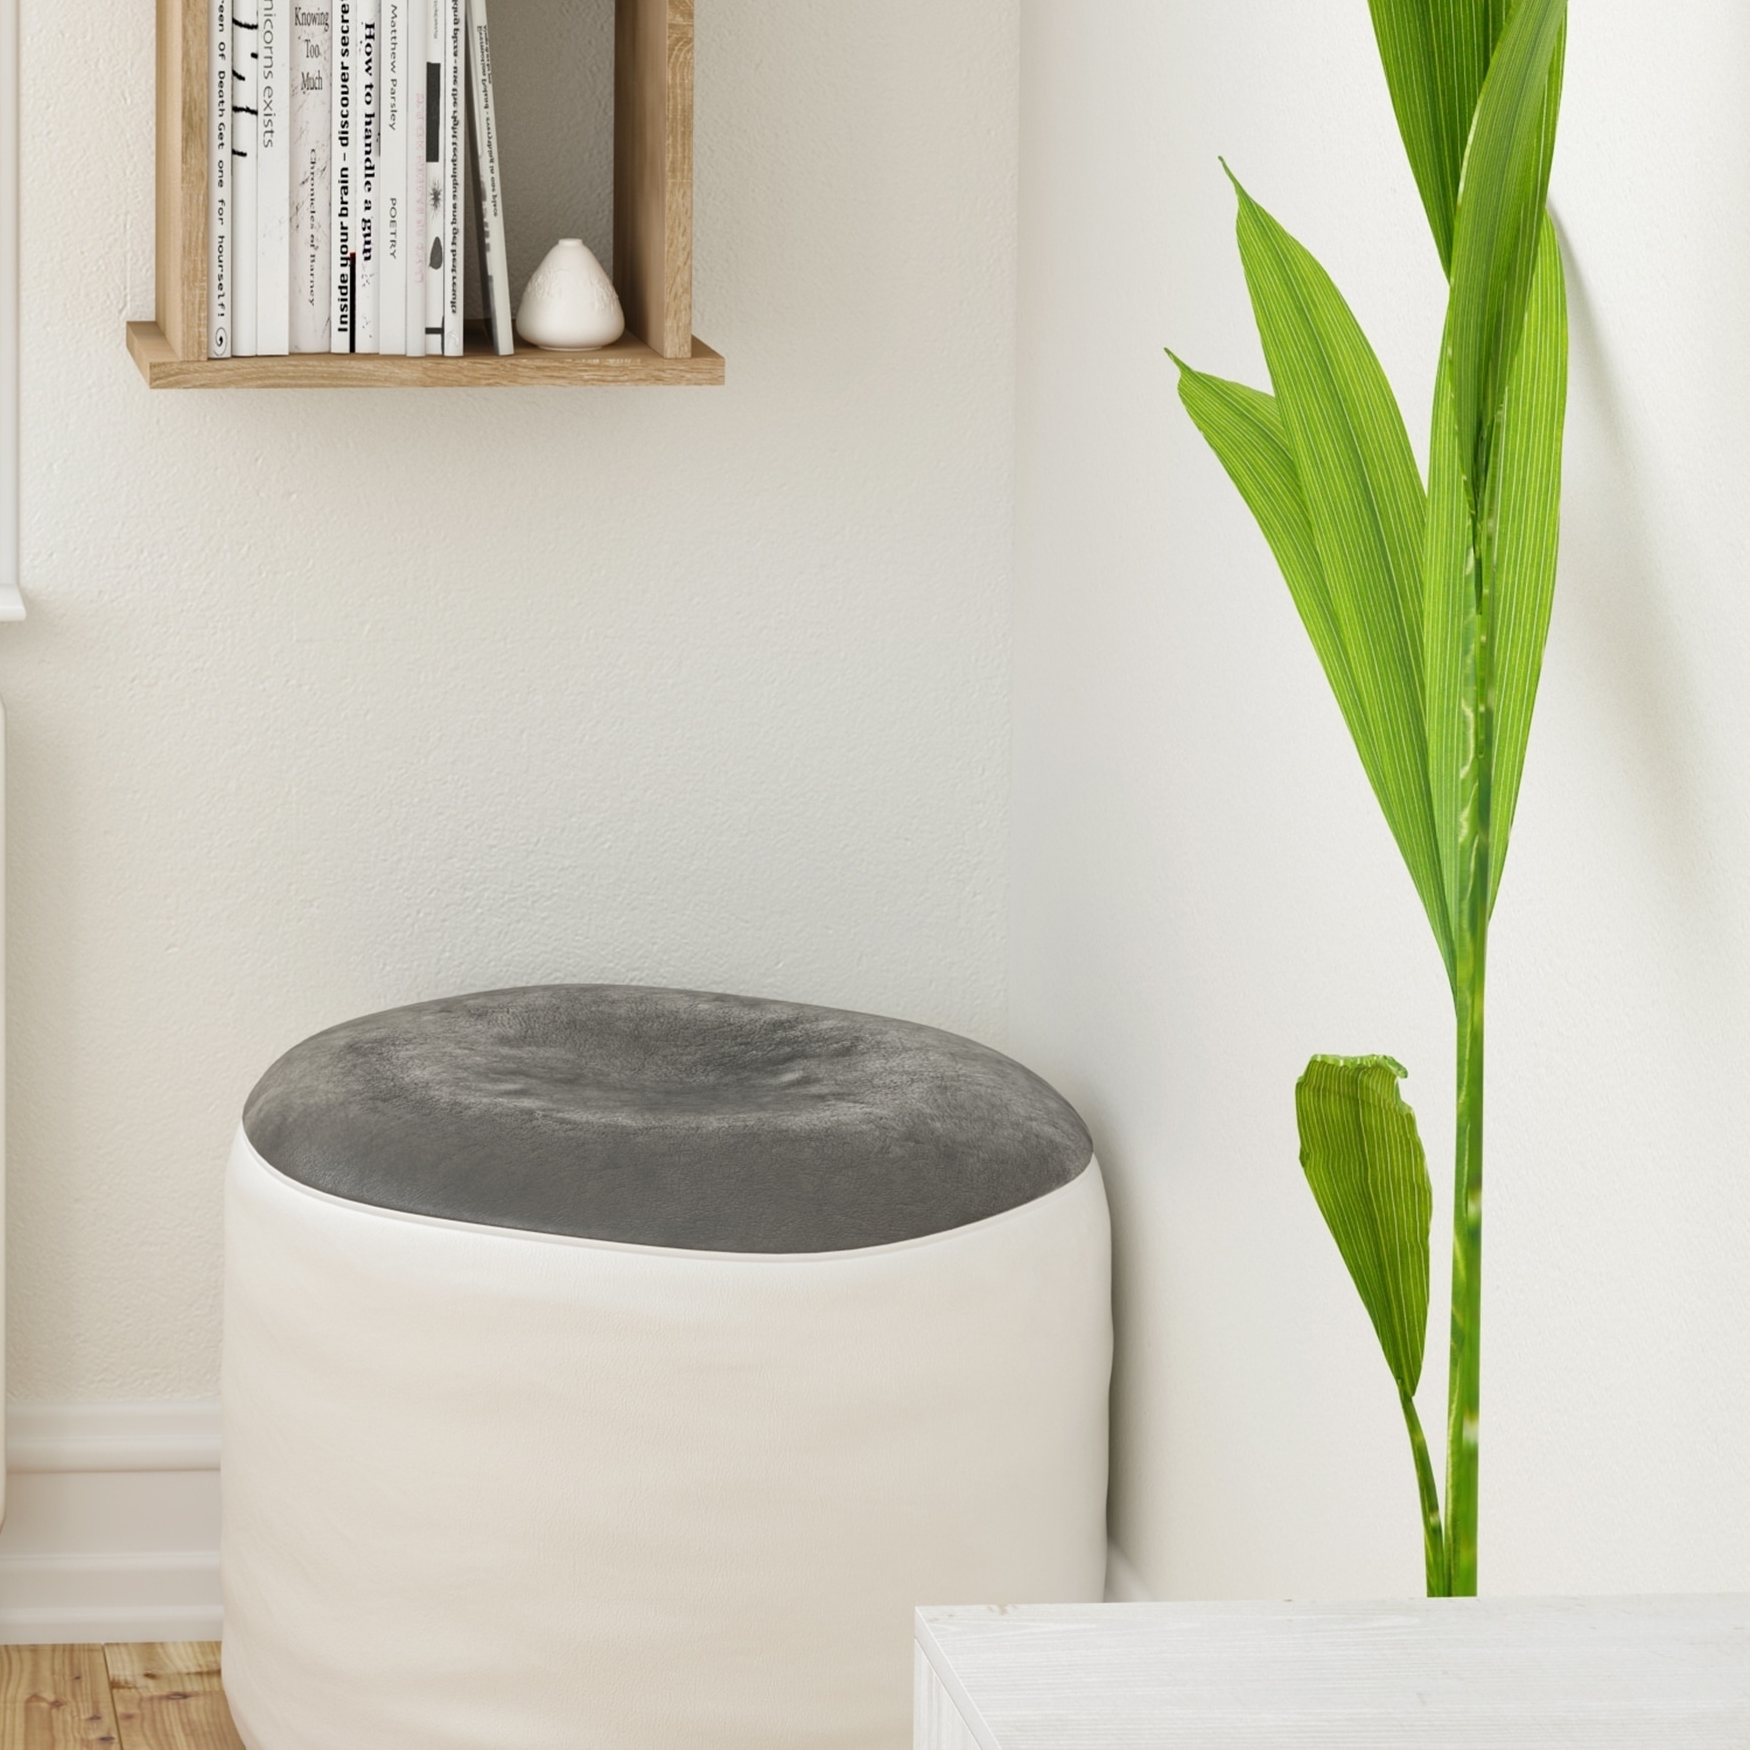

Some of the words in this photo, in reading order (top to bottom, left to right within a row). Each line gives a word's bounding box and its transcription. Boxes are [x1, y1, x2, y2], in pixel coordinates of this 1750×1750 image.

[293, 6, 330, 33] Knowing
[389, 3, 399, 74] Matthew
[217, 41, 226, 61] Of
[304, 38, 321, 59] Too
[363, 21, 376, 77] How
[217, 70, 226, 118] Death
[300, 70, 323, 92] Much
[363, 82, 375, 106] to
[387, 78, 399, 131] Parsley
[217, 121, 226, 150] Get
[262, 85, 277, 149] exists
[362, 111, 376, 193] handle
[217, 198, 226, 226] for
[309, 148, 317, 230] Chronicles
[336, 166, 350, 218] brain
[363, 198, 373, 212] a
[309, 233, 317, 250] of
[336, 220, 353, 268] your
[360, 217, 374, 262] gun
[388, 197, 398, 260] POETRY
[308, 254, 316, 307] Barney
[337, 272, 350, 333] Inside
